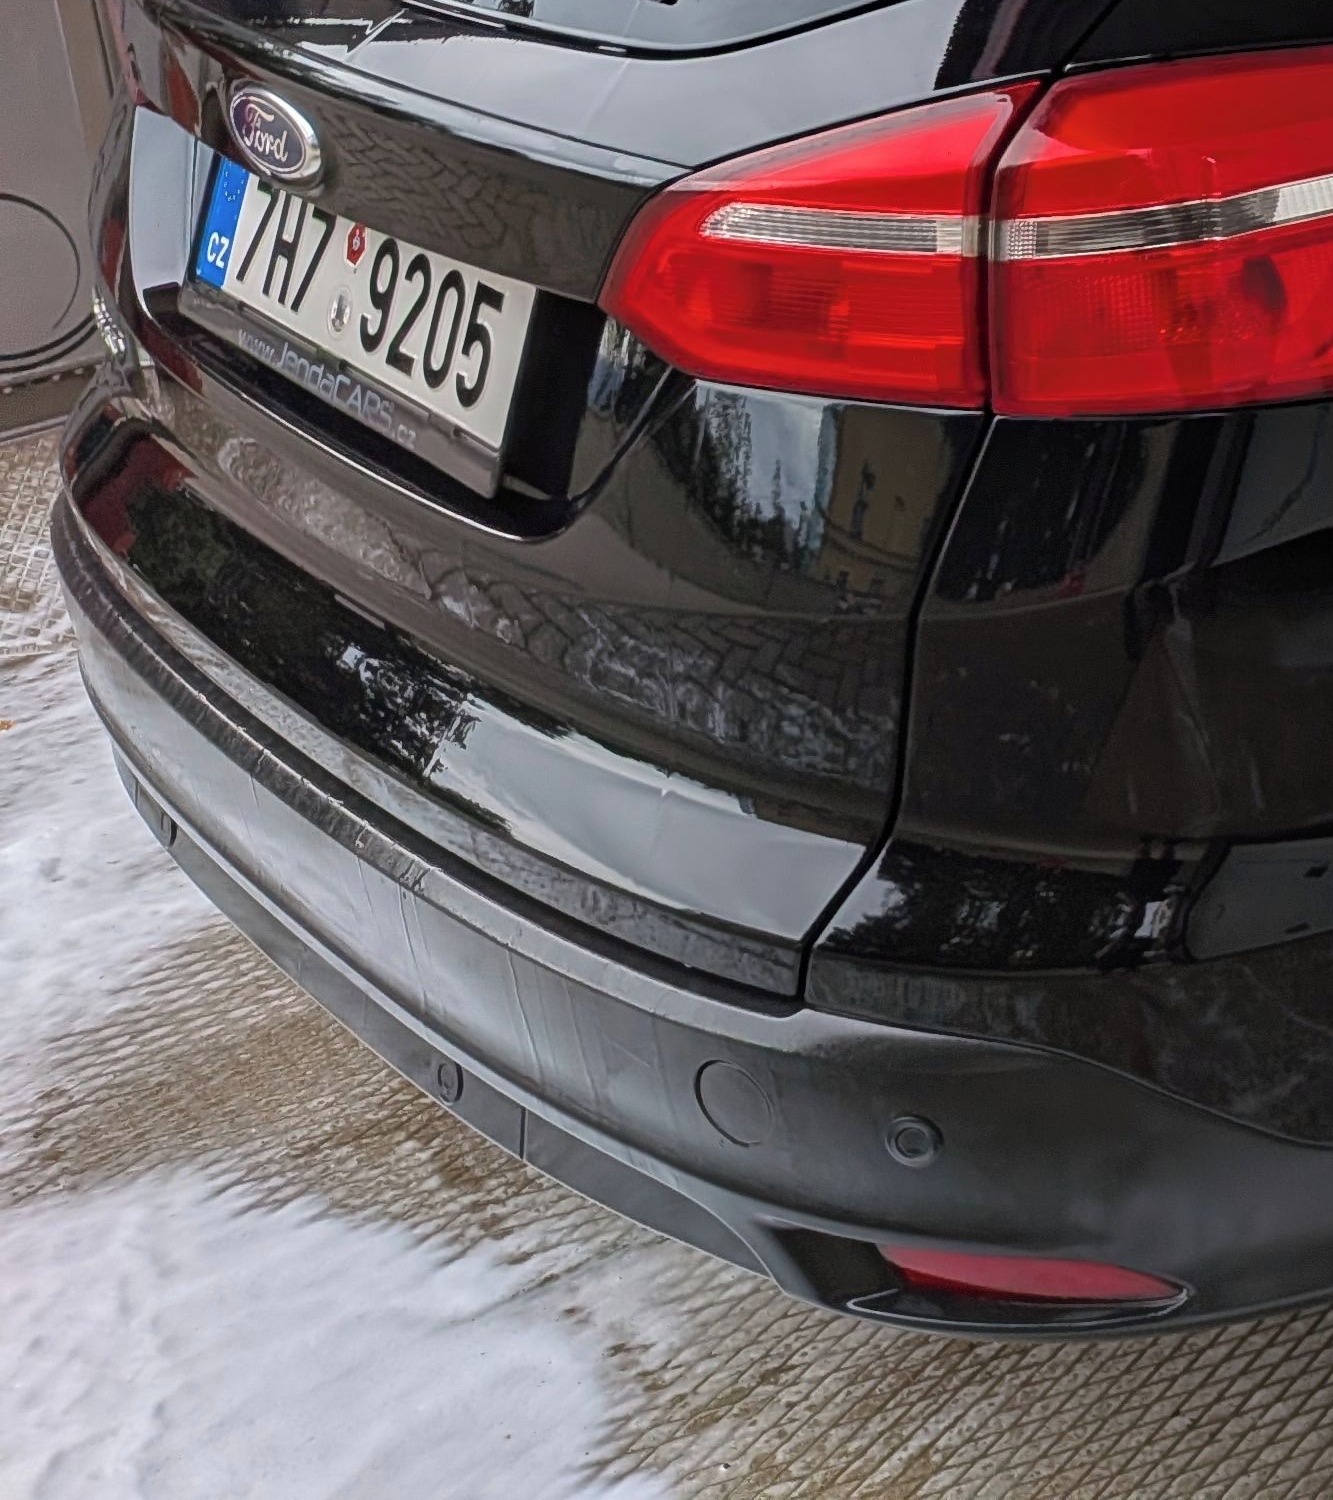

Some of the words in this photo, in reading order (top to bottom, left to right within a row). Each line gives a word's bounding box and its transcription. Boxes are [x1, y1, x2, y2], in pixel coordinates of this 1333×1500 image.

[241, 102, 289, 162] Ford
[206, 231, 230, 269] CZ
[235, 180, 338, 315] 7H7
[359, 236, 506, 408] 9205
